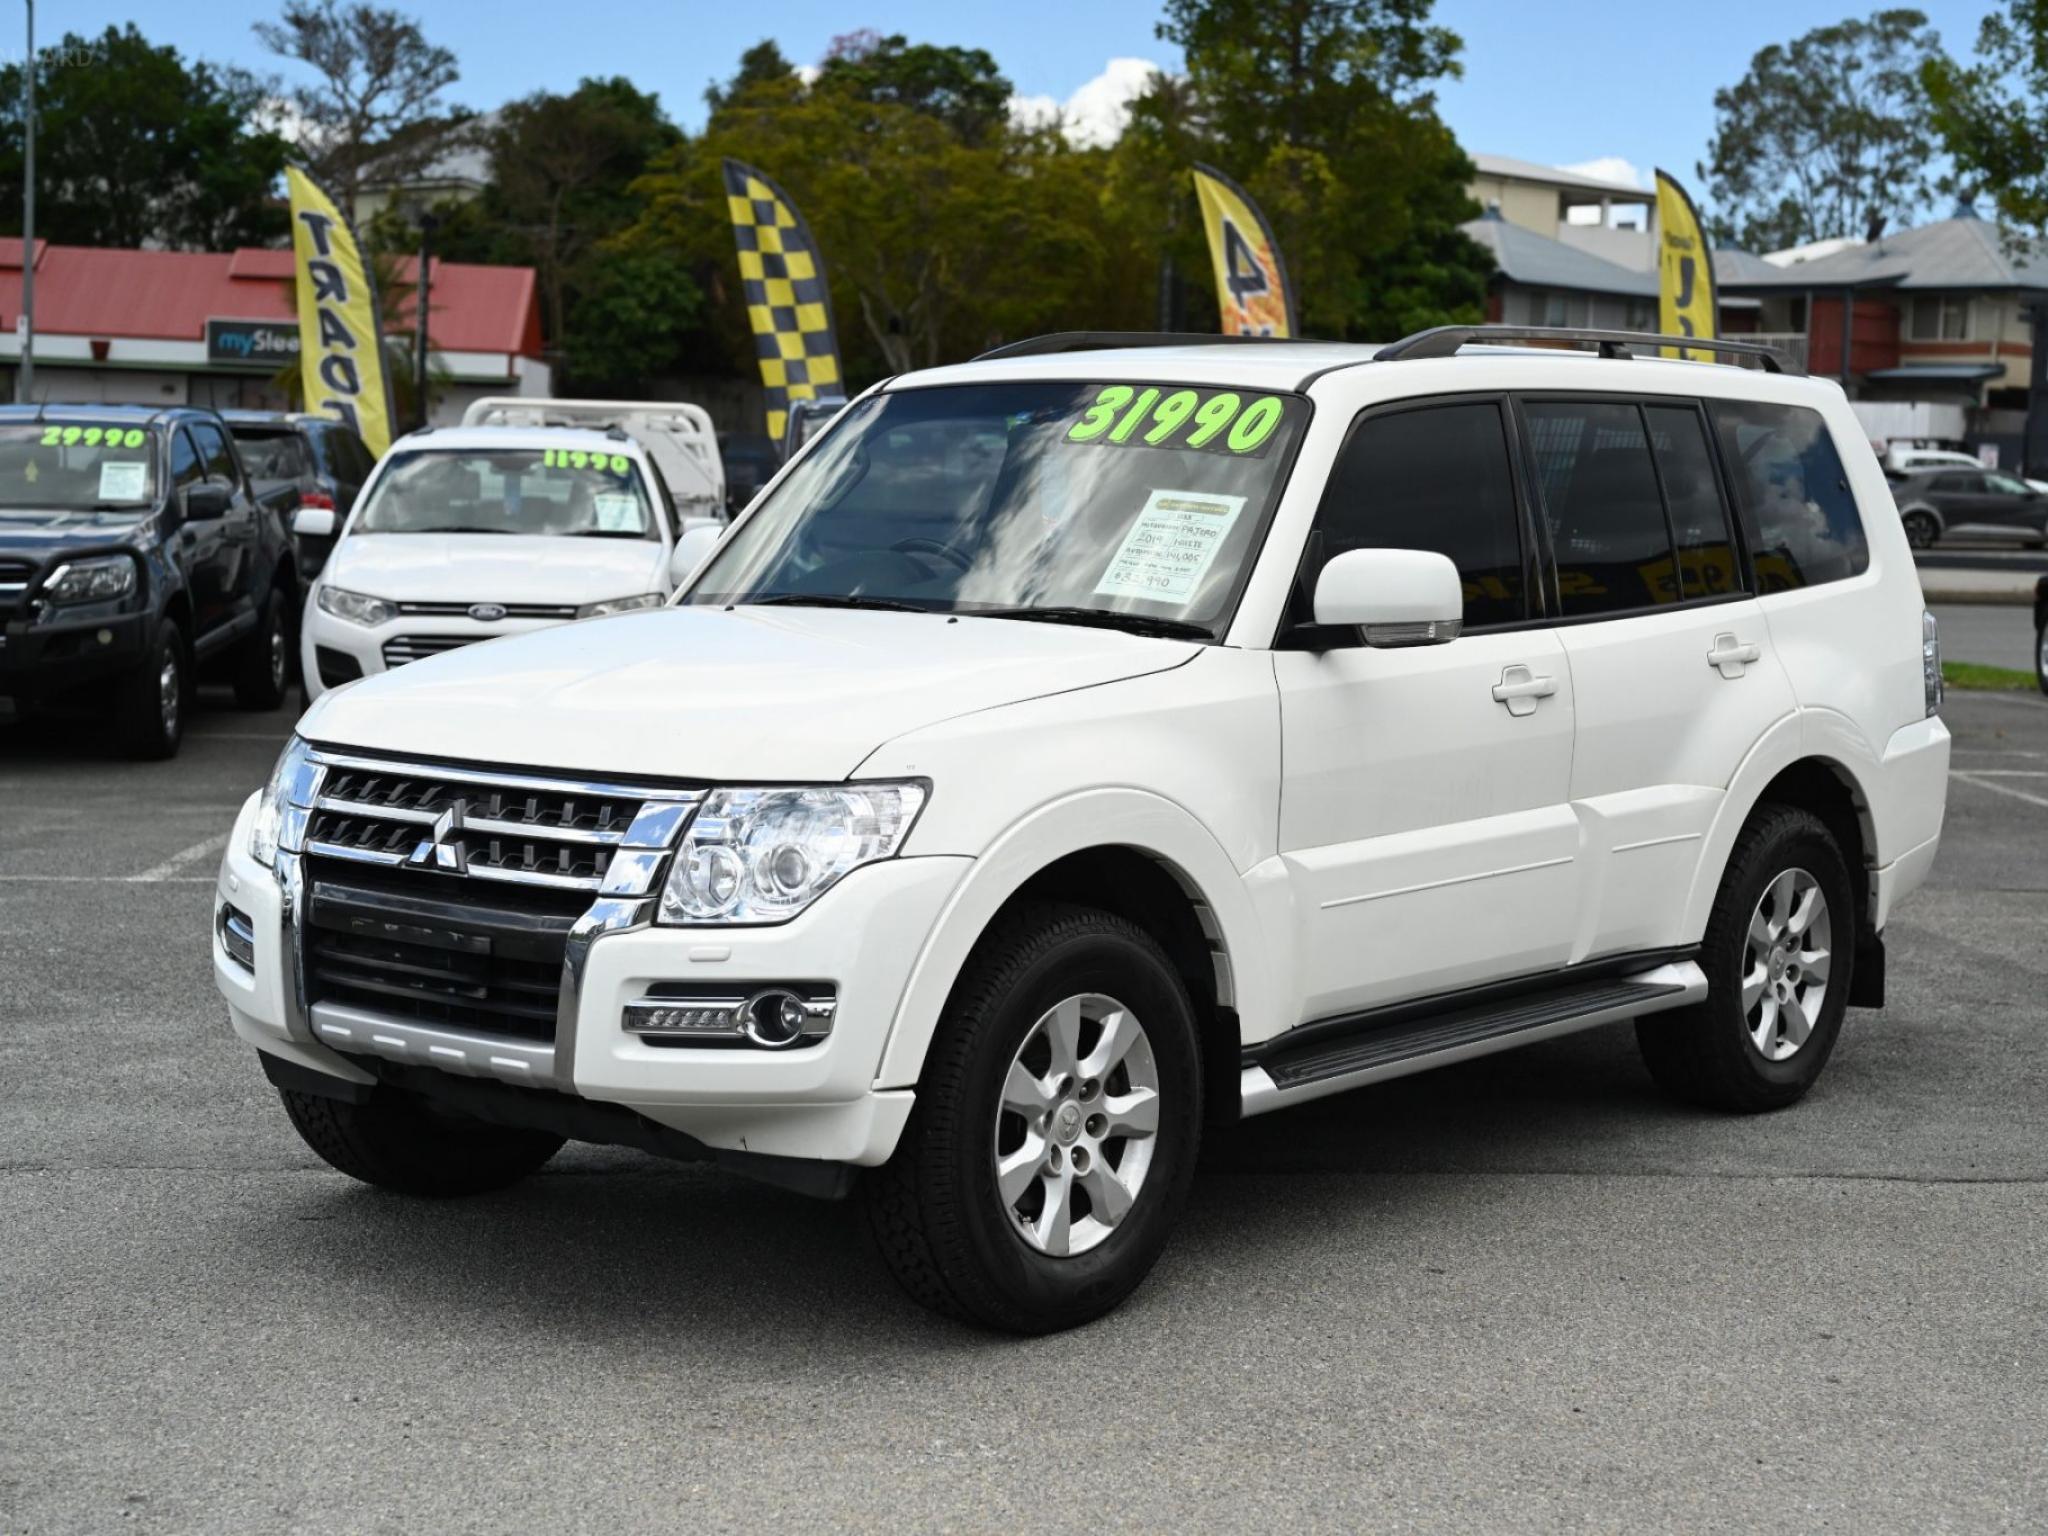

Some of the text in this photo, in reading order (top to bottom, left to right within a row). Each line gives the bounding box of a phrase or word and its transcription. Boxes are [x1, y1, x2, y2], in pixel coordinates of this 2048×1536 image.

[218, 328, 300, 357] mySlee
[1068, 385, 1284, 453] 31990
[41, 425, 145, 449] 29990
[544, 448, 631, 475] 11990
[1182, 524, 1217, 538] PAJERO
